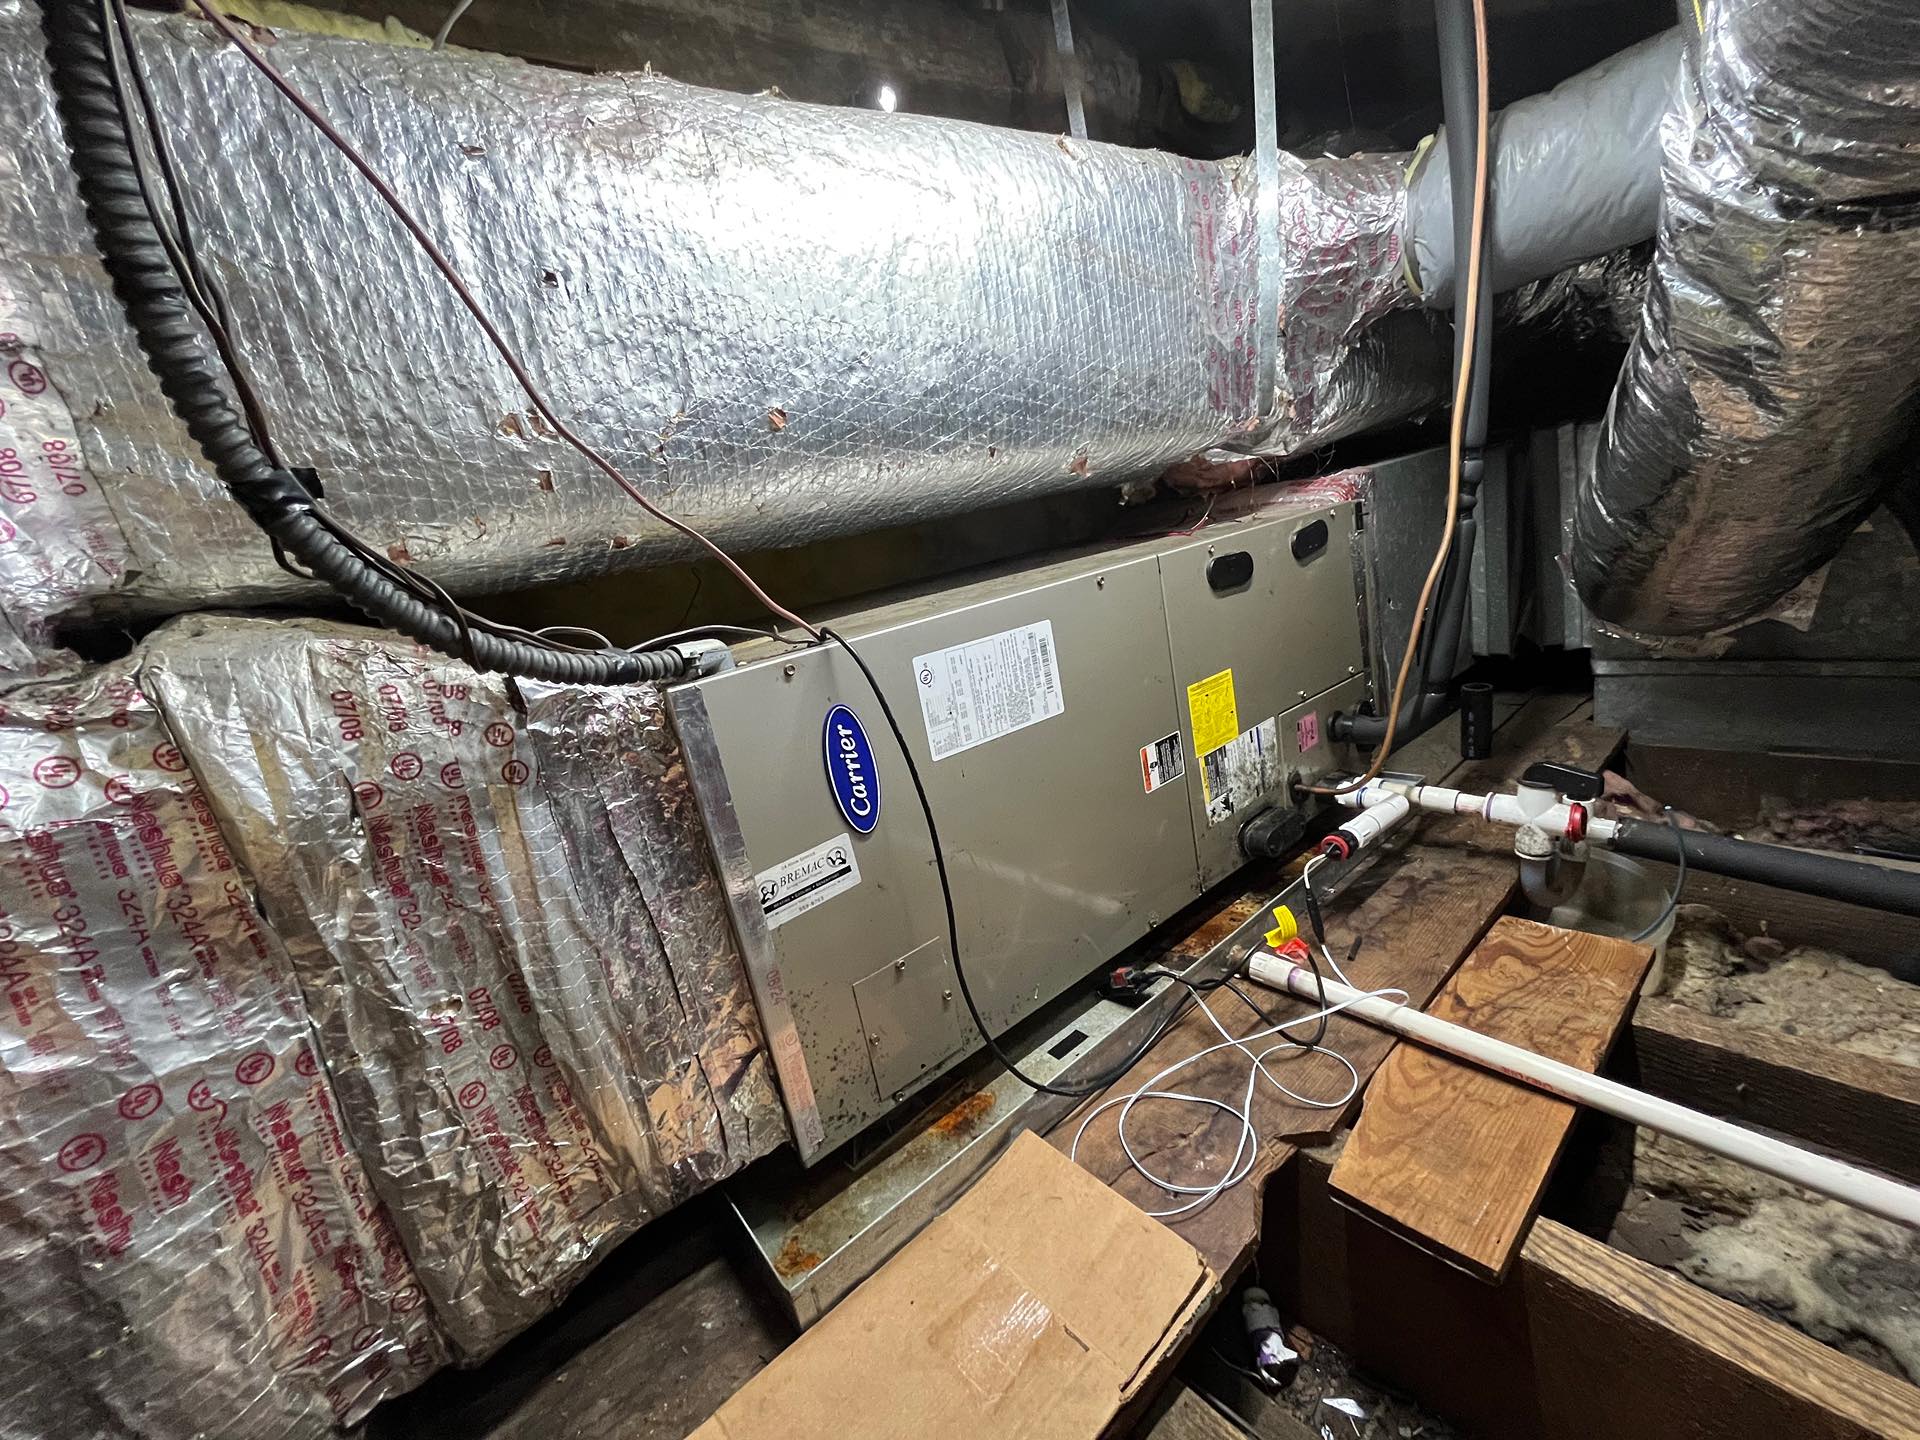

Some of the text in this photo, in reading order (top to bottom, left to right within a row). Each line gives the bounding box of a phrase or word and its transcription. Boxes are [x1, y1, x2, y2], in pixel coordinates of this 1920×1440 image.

[42, 440, 87, 496] 07/08
[332, 692, 366, 741] 07/08
[378, 684, 408, 732] 07/08
[837, 724, 871, 816] Carrier
[132, 797, 183, 890] Nashua
[165, 891, 210, 946] 324A
[369, 815, 411, 898] Nashua
[415, 804, 450, 886] Nashua
[780, 857, 824, 887] BREMAC
[52, 908, 98, 964] 324A
[469, 988, 500, 1030] 07/08
[150, 1138, 197, 1203] Nash
[267, 1104, 309, 1184] Nashua
[288, 1186, 326, 1235] 324A
[479, 1109, 521, 1177] Nashua
[215, 1131, 261, 1217] Nashua
[244, 1218, 277, 1269] 324A
